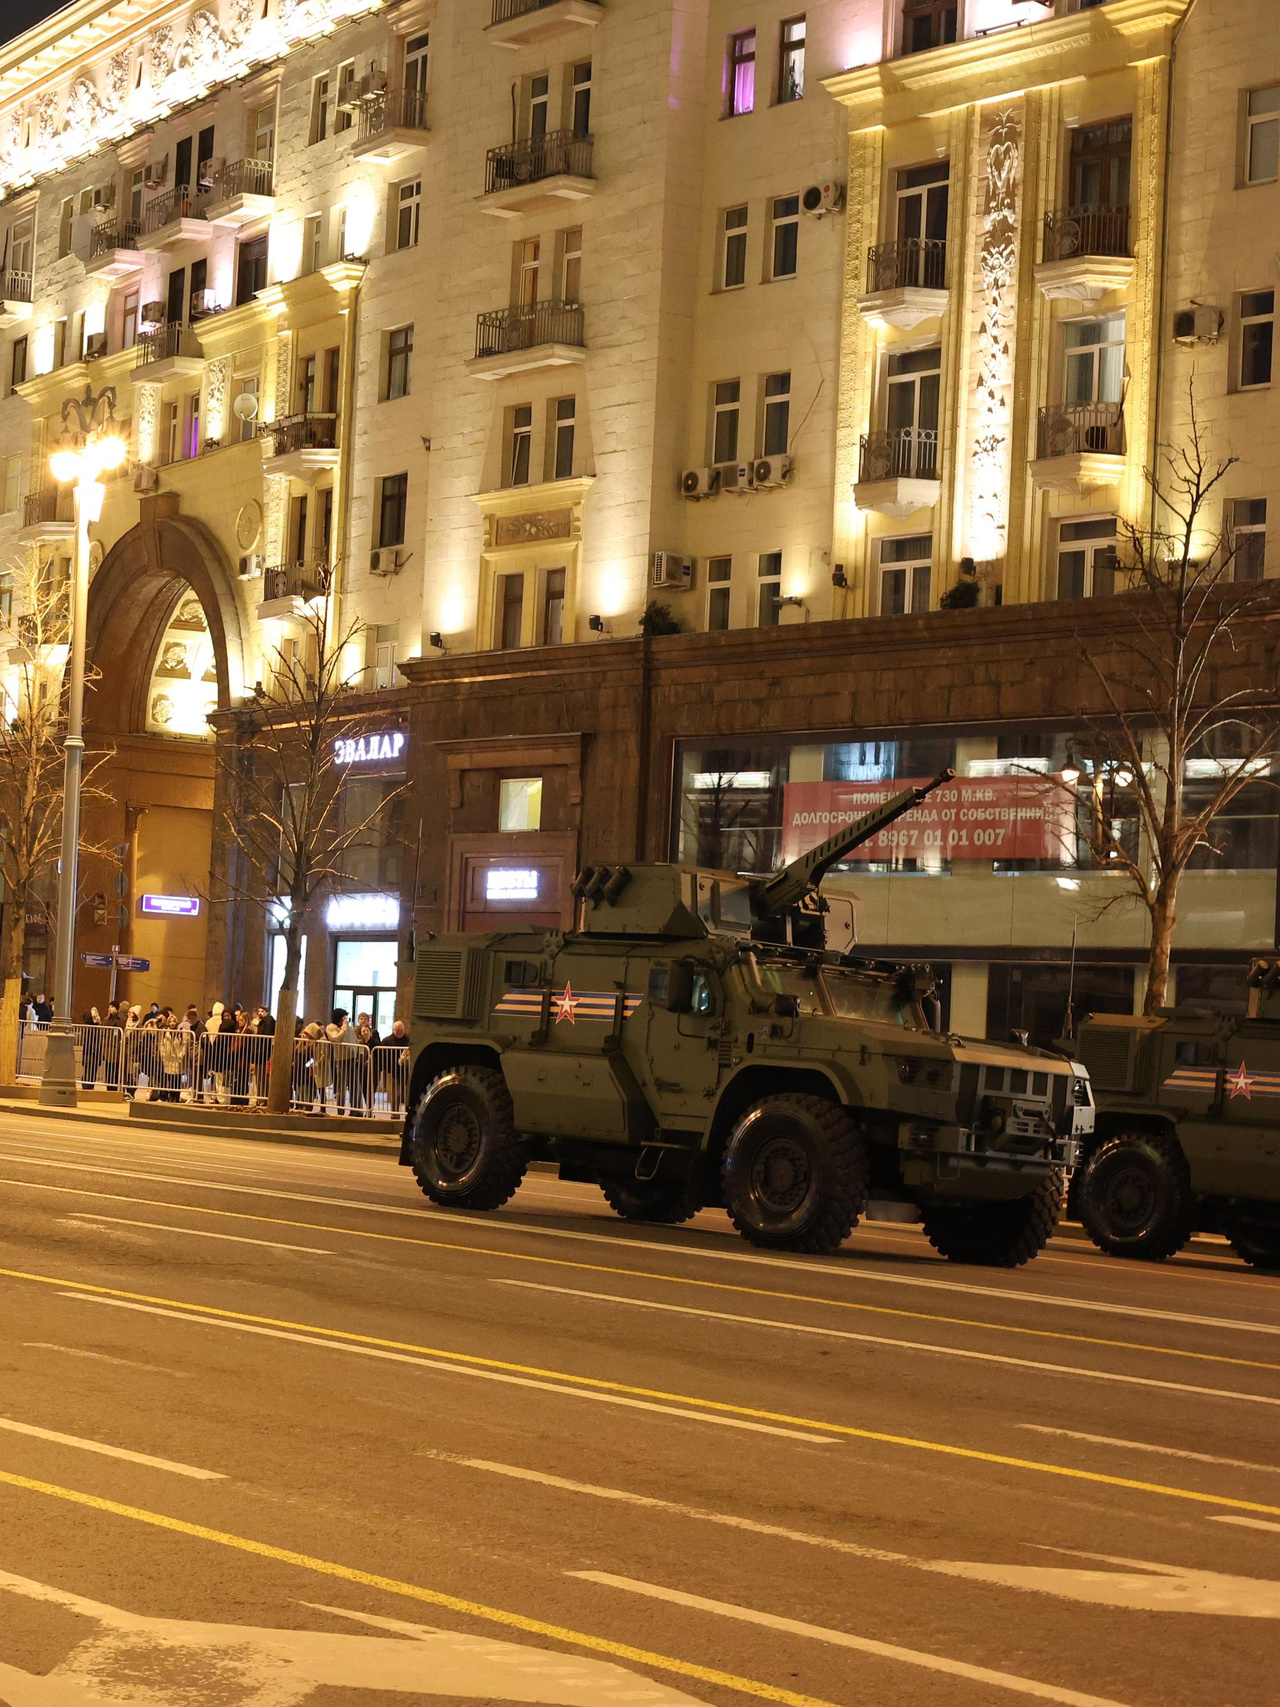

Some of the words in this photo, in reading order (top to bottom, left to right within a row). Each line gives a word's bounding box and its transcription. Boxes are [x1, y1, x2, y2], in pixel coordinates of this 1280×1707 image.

[334, 732, 405, 765] ЭВАЛАР
[852, 790, 932, 805] ПОМЕЕ
[935, 789, 958, 803] 730
[893, 808, 938, 824] РЕНДА
[941, 808, 958, 821] ОТ
[877, 829, 919, 847] 8967
[923, 828, 944, 846] 01
[948, 828, 969, 846] 01
[973, 828, 1006, 846] 007
